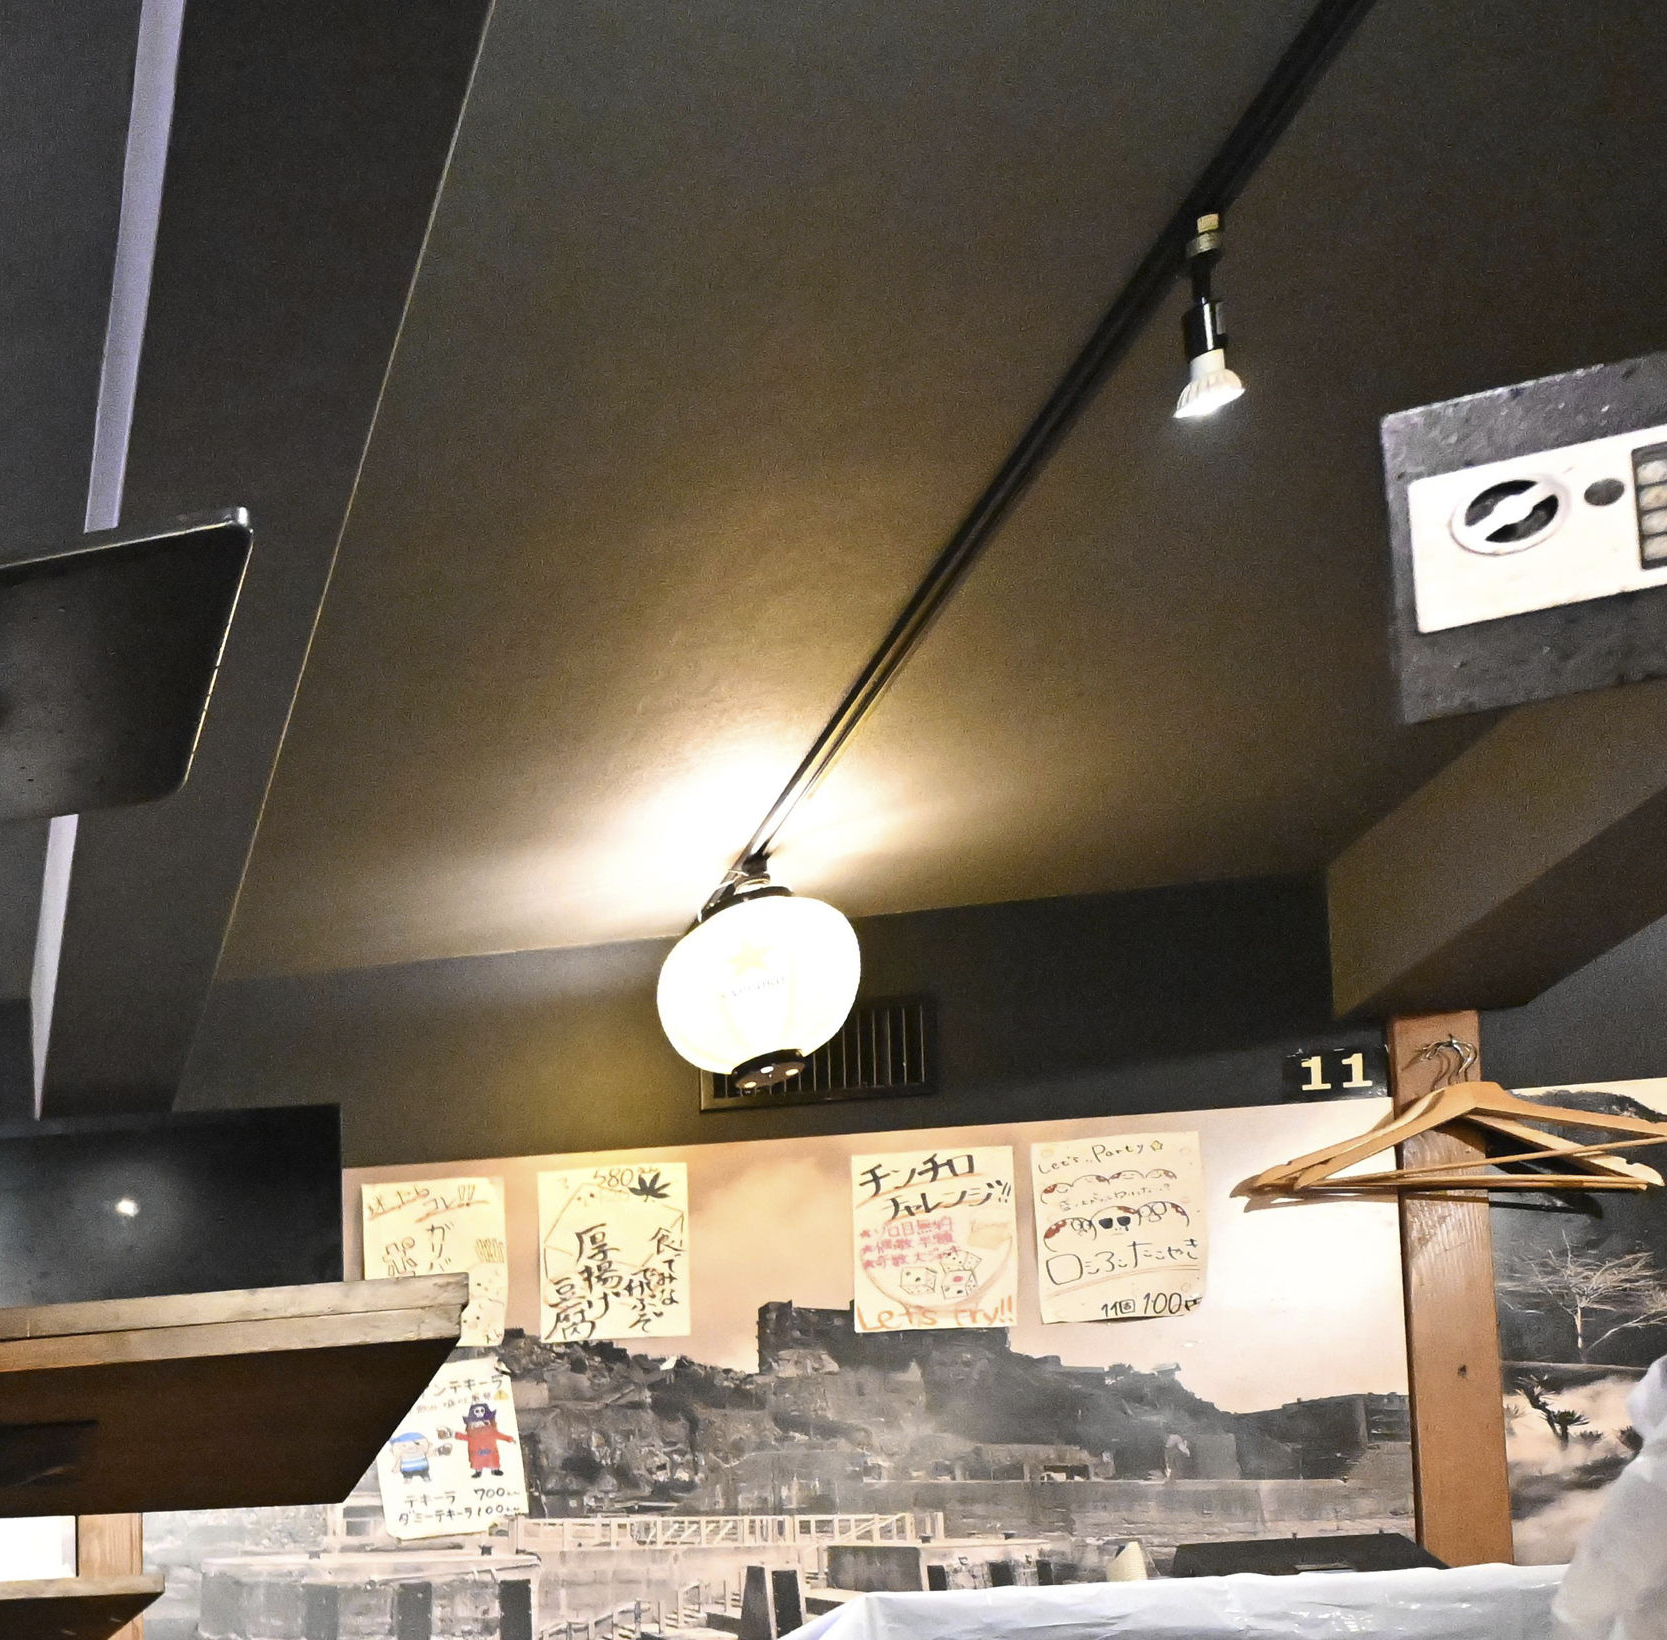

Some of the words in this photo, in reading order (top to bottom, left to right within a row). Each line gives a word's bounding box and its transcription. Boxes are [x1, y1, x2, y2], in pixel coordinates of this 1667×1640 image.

[1300, 1052, 1374, 1091] 11
[859, 1153, 975, 1199] チンチロ
[405, 1490, 457, 1508] テキーラ
